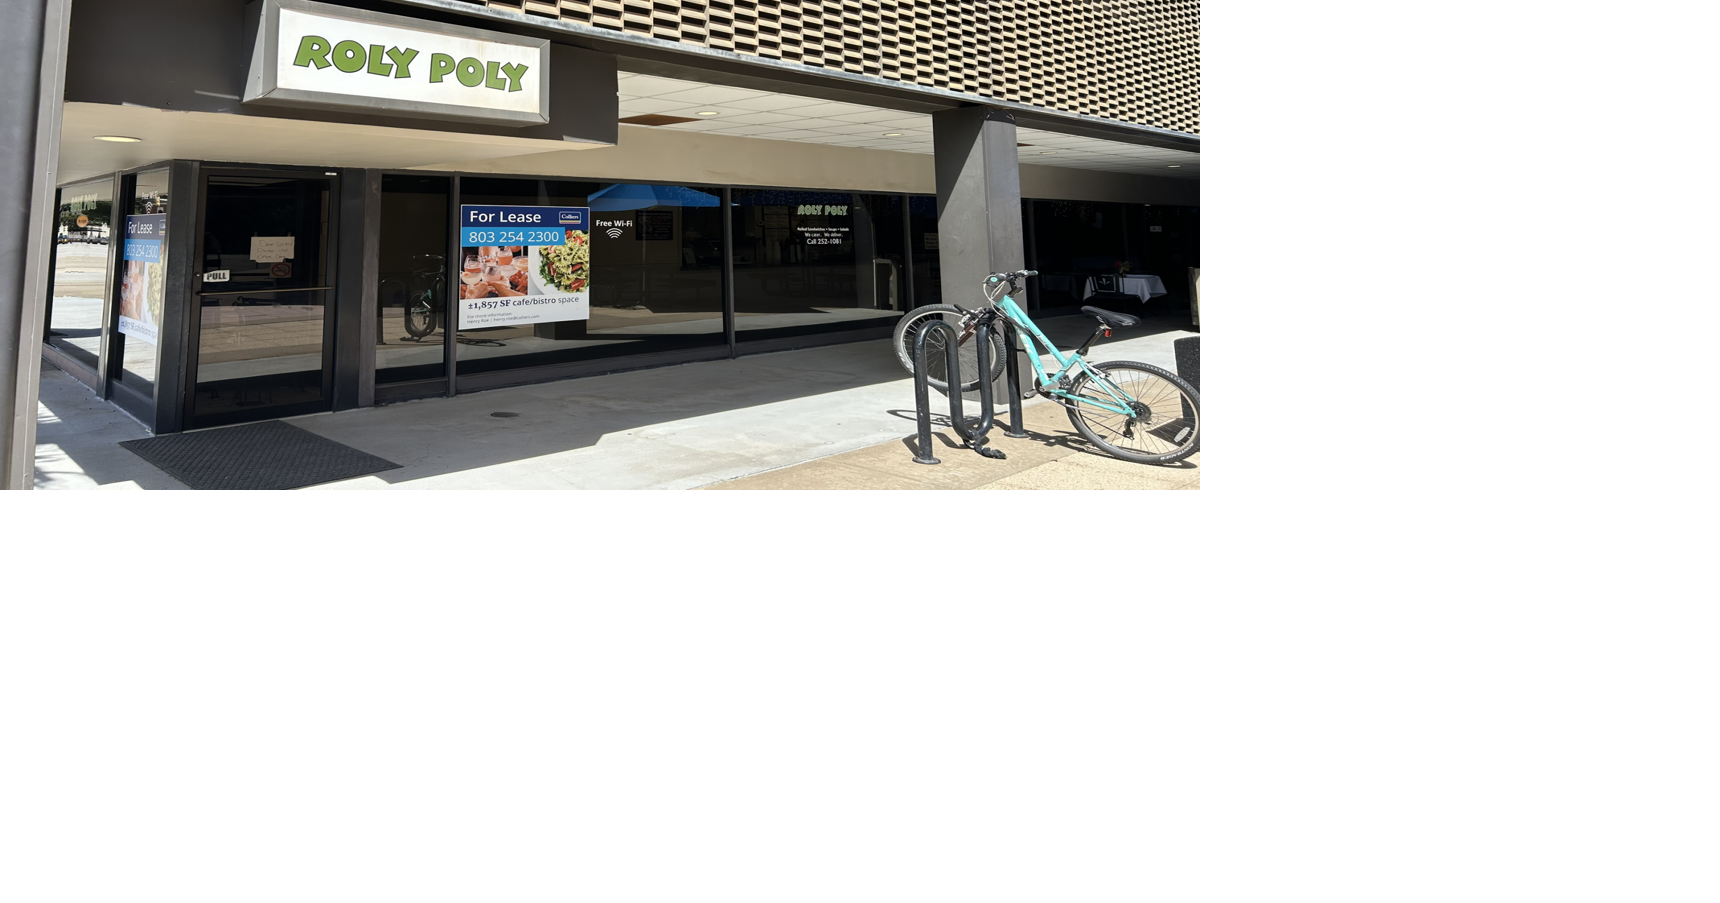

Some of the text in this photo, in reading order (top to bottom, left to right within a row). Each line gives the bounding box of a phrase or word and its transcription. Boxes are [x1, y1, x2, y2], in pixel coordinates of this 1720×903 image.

[293, 35, 529, 93] ROLY POLY
[470, 210, 541, 223] For Lease
[797, 204, 848, 216] ROLY POLY
[128, 221, 137, 234] For
[137, 221, 153, 234] Lease
[595, 219, 633, 227] Free Wi-Fi
[469, 231, 559, 243] 803 254 2300
[126, 244, 158, 259] 803 254 2300
[206, 272, 227, 280] PULL
[468, 296, 580, 311] ±1,857 SF cafe/bistro space
